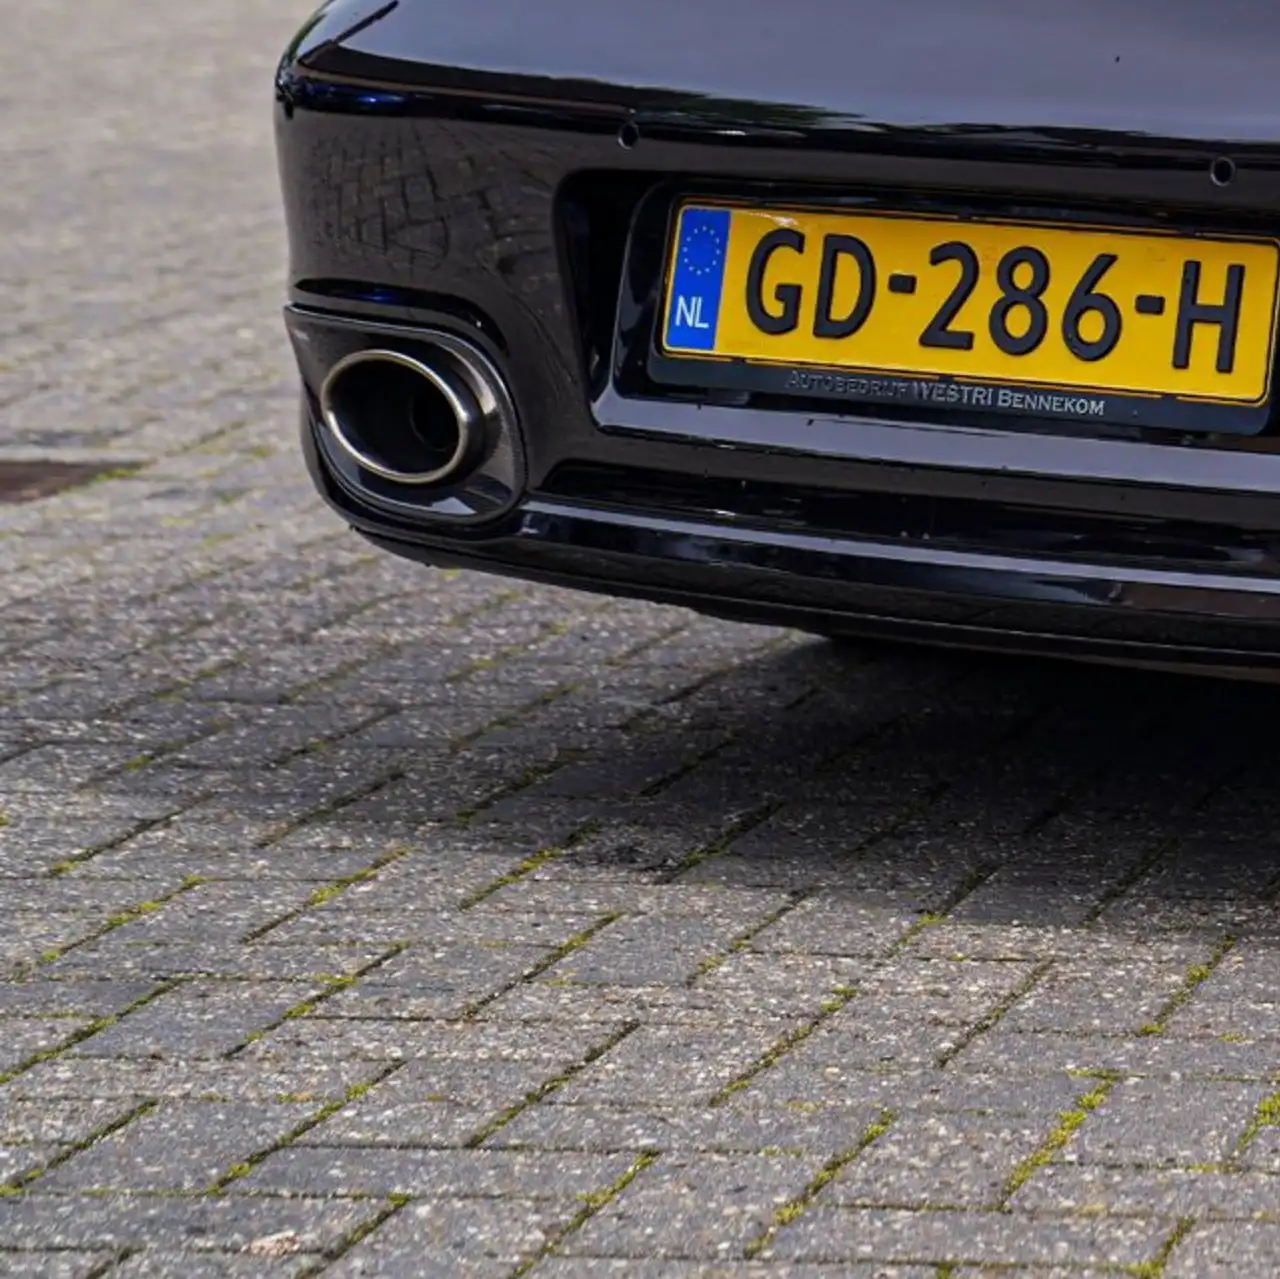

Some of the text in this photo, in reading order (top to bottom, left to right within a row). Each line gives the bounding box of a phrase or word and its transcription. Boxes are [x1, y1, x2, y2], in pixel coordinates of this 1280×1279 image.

[674, 295, 709, 329] NL
[744, 227, 1246, 374] GD-286-H
[911, 379, 993, 407] WESTRI
[996, 388, 1106, 417] BENNEKOM
